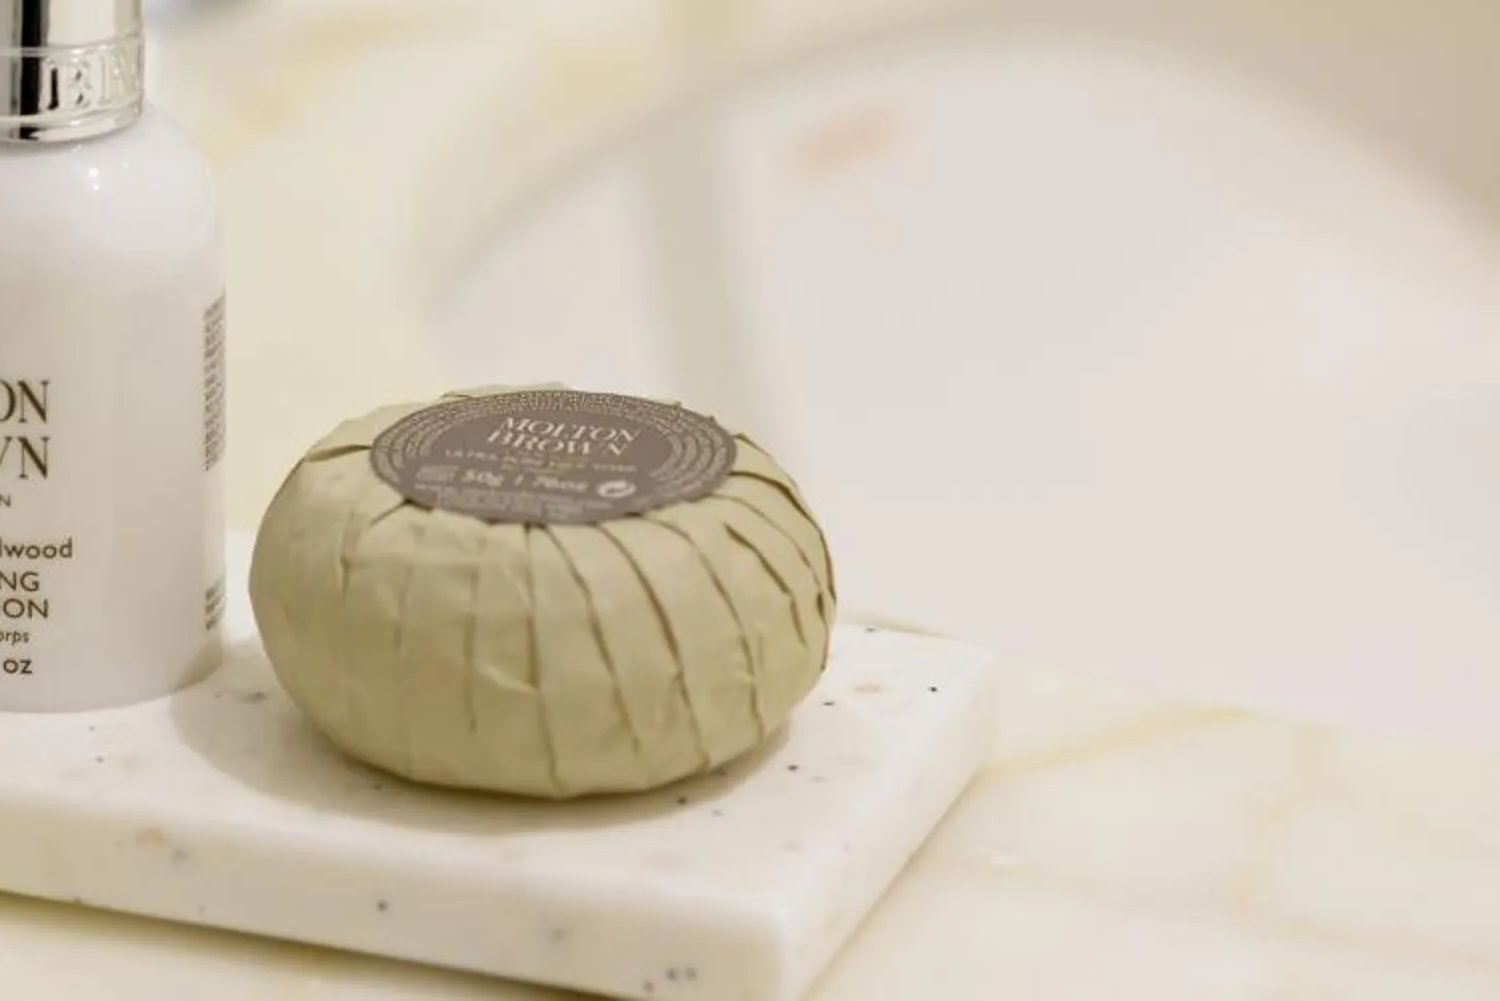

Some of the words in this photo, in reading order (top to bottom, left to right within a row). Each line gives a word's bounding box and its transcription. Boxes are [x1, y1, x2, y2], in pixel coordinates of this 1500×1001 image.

[499, 416, 642, 442] MOLTON
[486, 429, 628, 456] BROWN
[3, 658, 33, 675] oz
